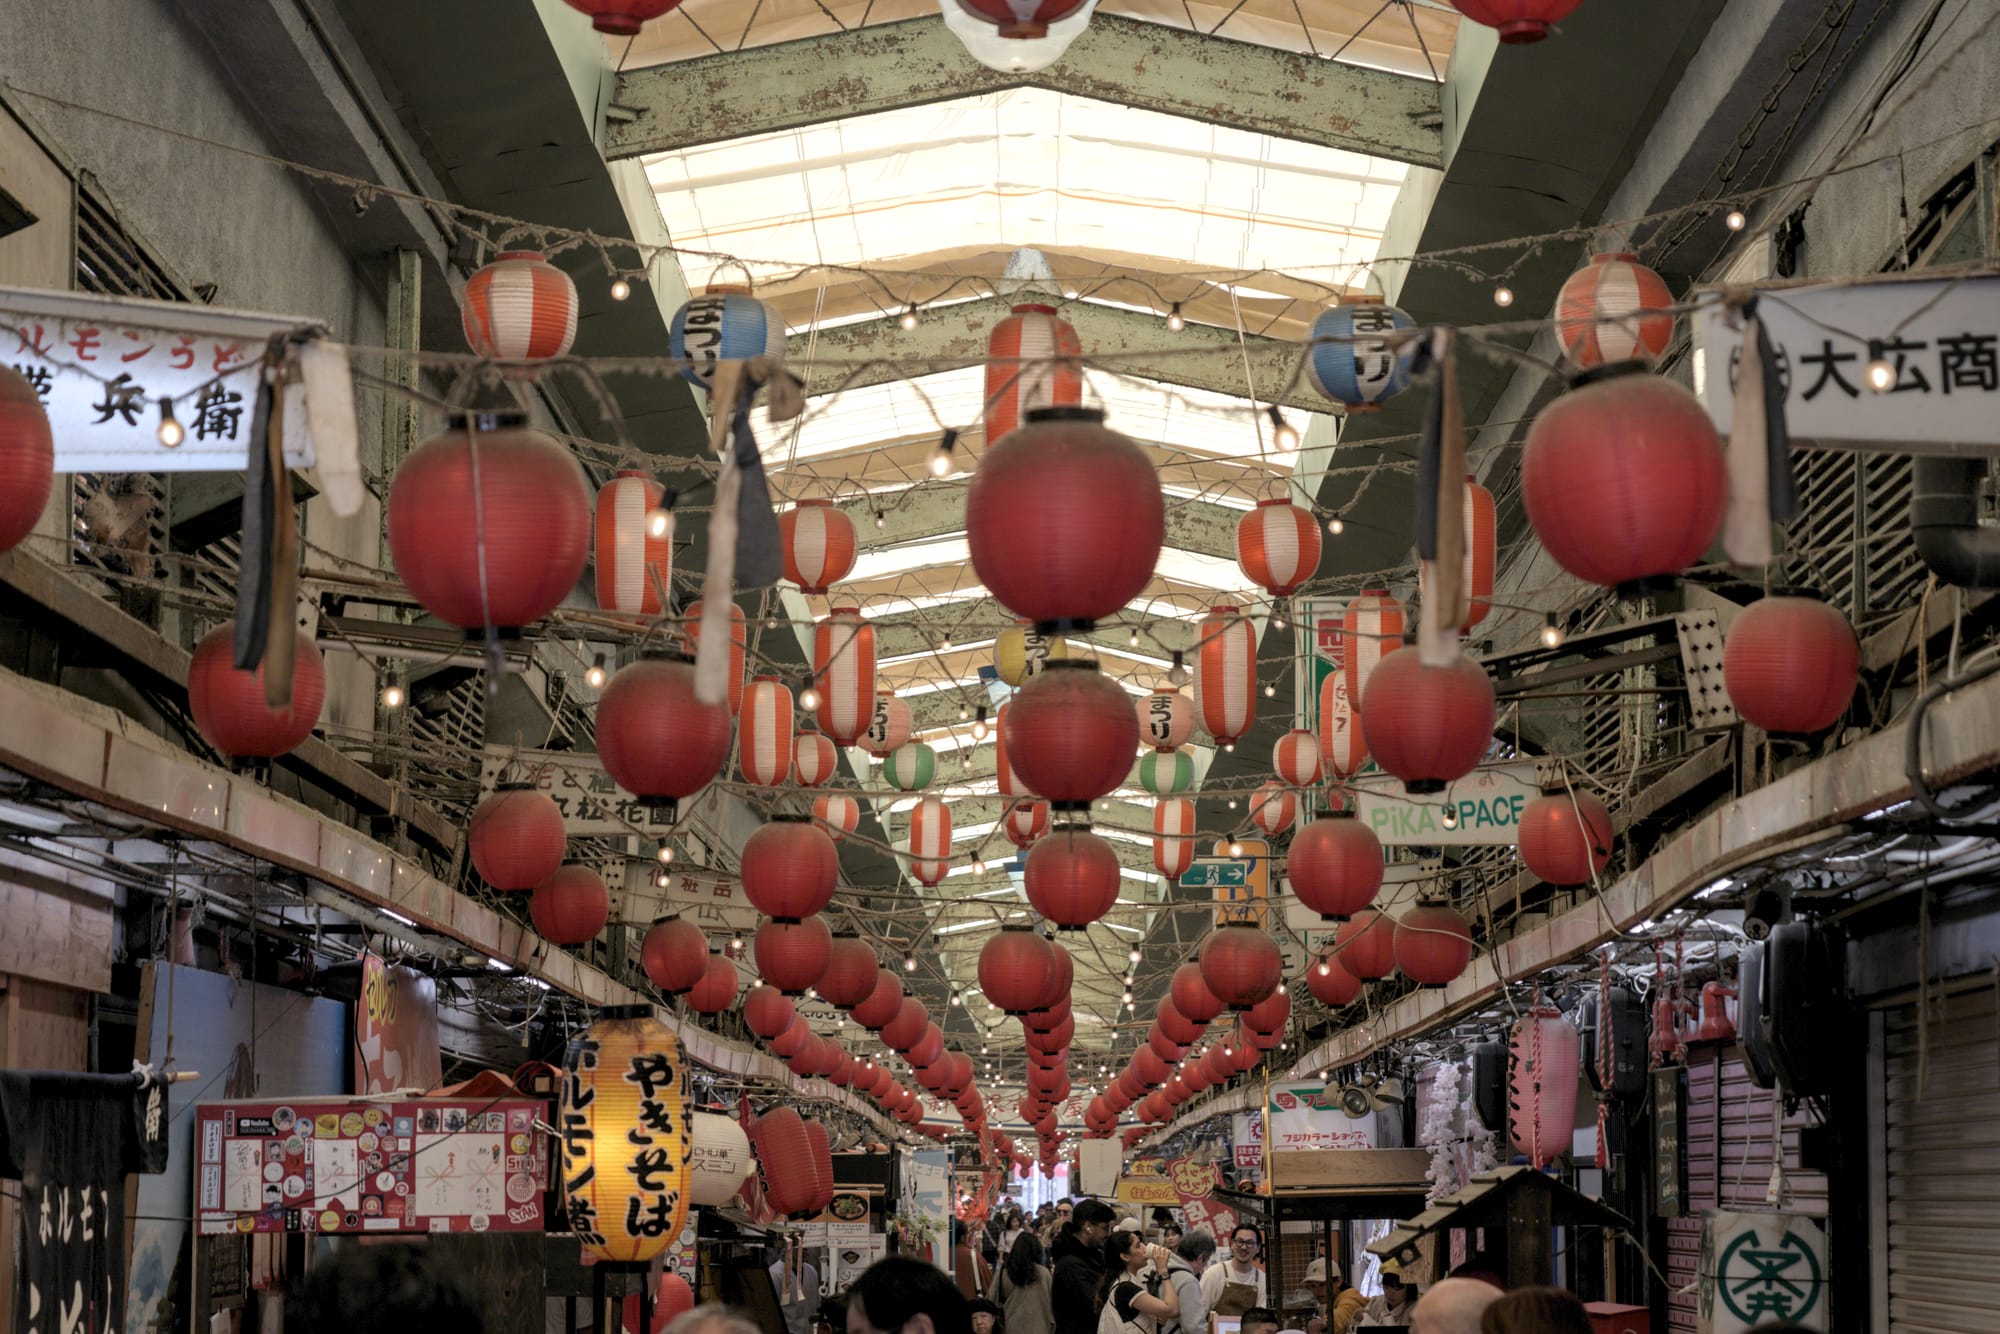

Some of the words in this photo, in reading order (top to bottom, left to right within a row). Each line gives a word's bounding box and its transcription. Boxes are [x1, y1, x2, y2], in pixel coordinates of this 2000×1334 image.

[1149, 695, 1173, 740] まつり
[625, 1053, 678, 1238] やきそば
